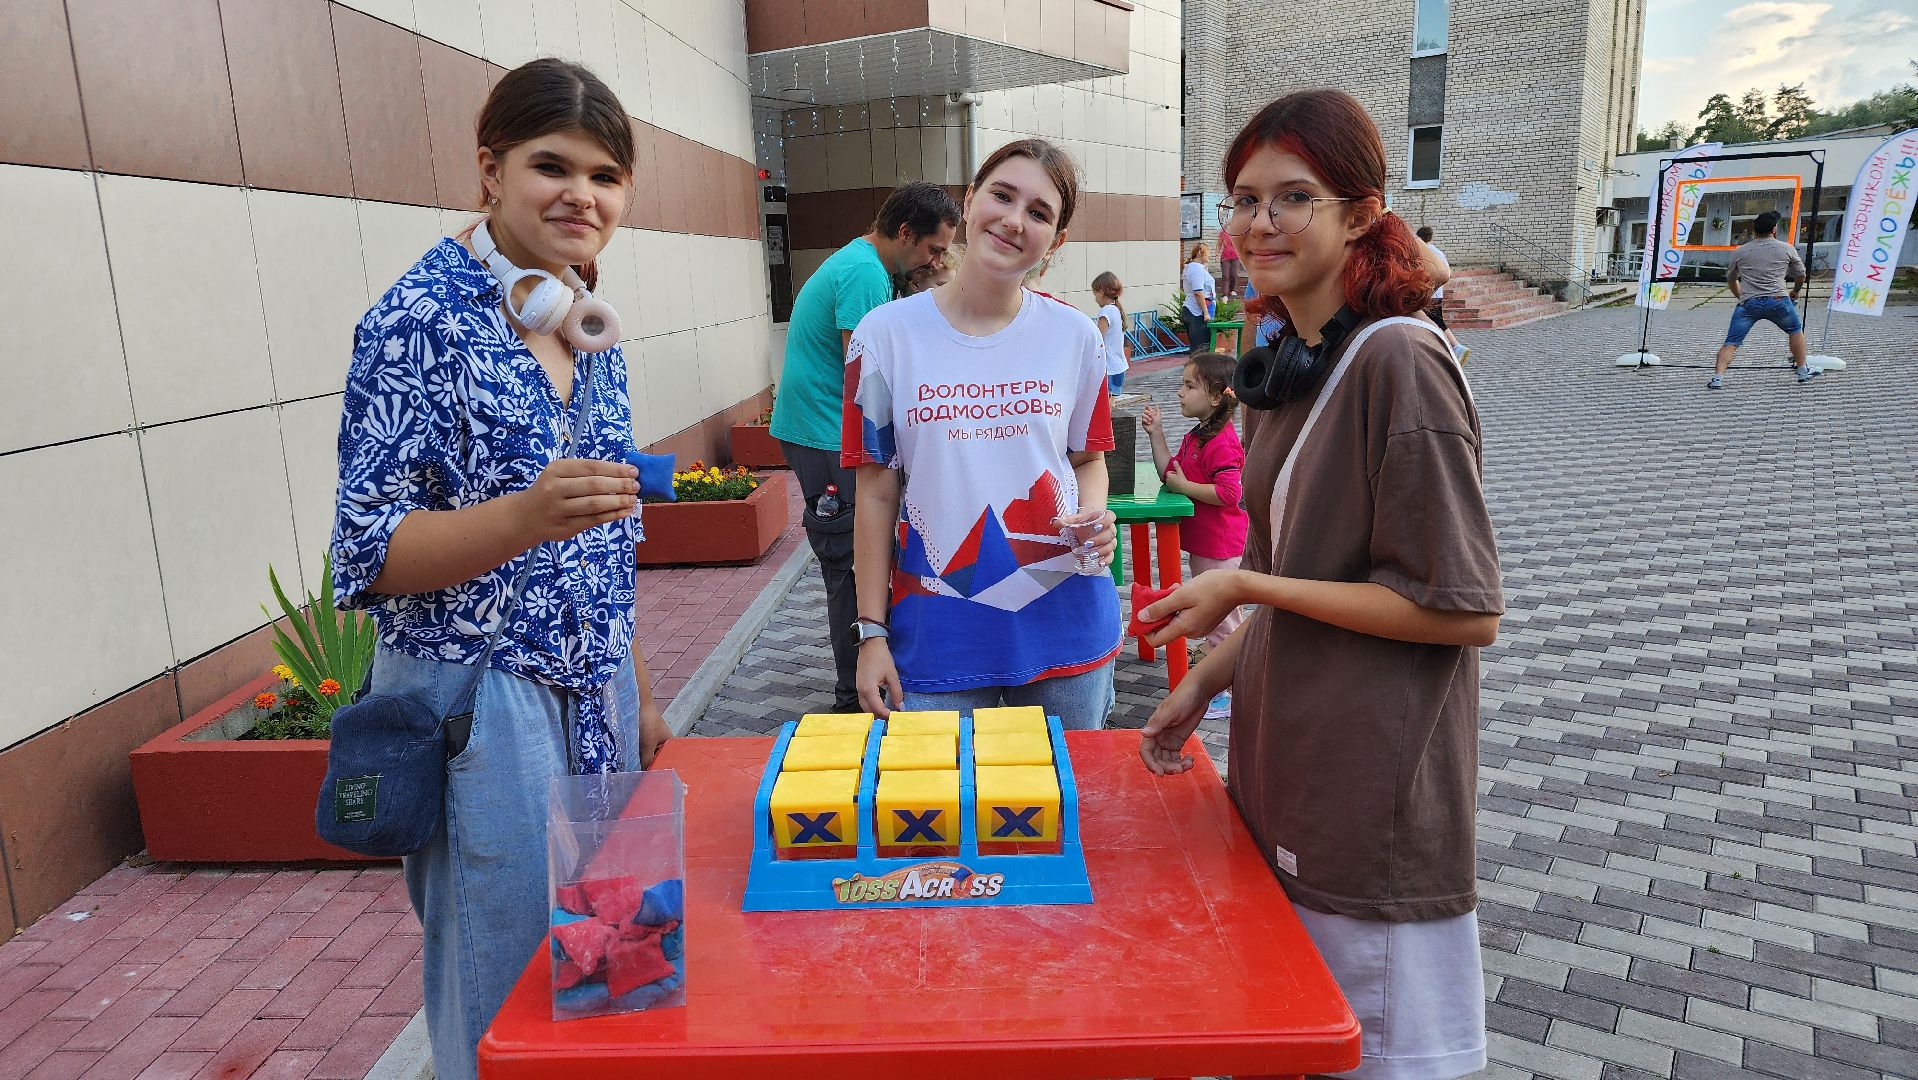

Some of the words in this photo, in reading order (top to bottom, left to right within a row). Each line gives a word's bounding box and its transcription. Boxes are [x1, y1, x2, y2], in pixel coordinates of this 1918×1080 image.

[1842, 263, 1853, 273] С
[918, 379, 1054, 402] ВОЛОНТЕРЫ
[907, 398, 1062, 427] ПОДМОСКОВЬЯ
[948, 428, 972, 441] МЫ
[975, 423, 1029, 442] РЯДОМ
